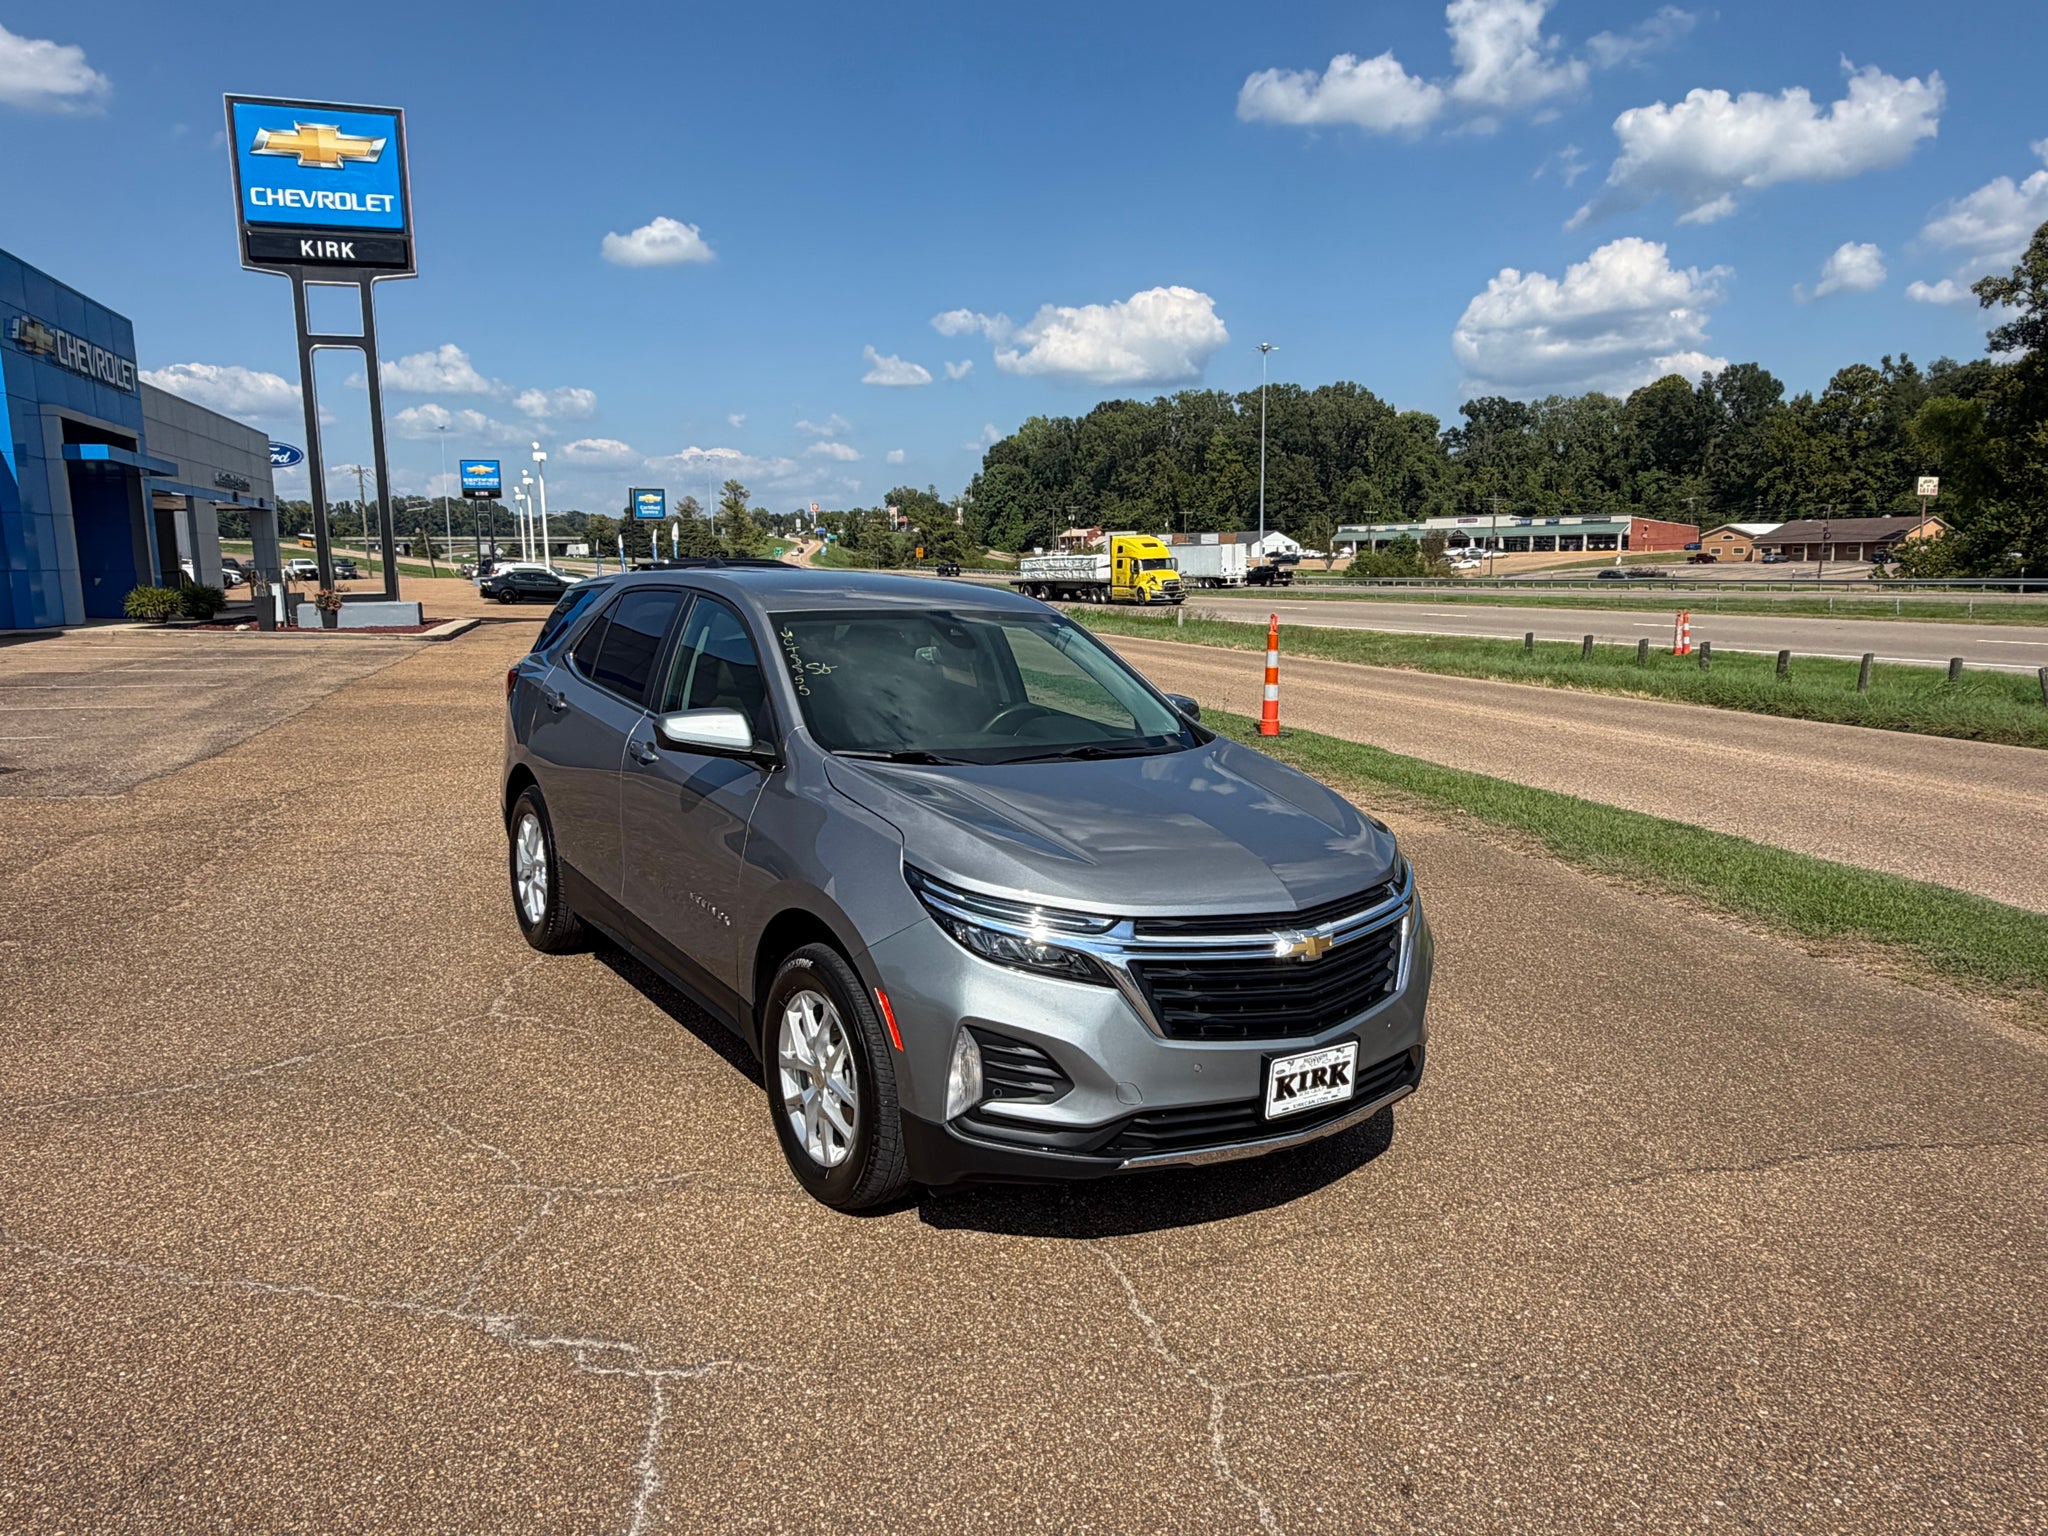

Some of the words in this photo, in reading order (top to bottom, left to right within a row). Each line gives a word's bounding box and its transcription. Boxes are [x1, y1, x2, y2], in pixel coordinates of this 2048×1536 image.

[250, 187, 395, 213] CHEVROLET
[300, 239, 356, 259] KIRK
[56, 328, 136, 393] CHEVROLET
[269, 447, 290, 463] rd
[1272, 1059, 1351, 1103] KIRK
